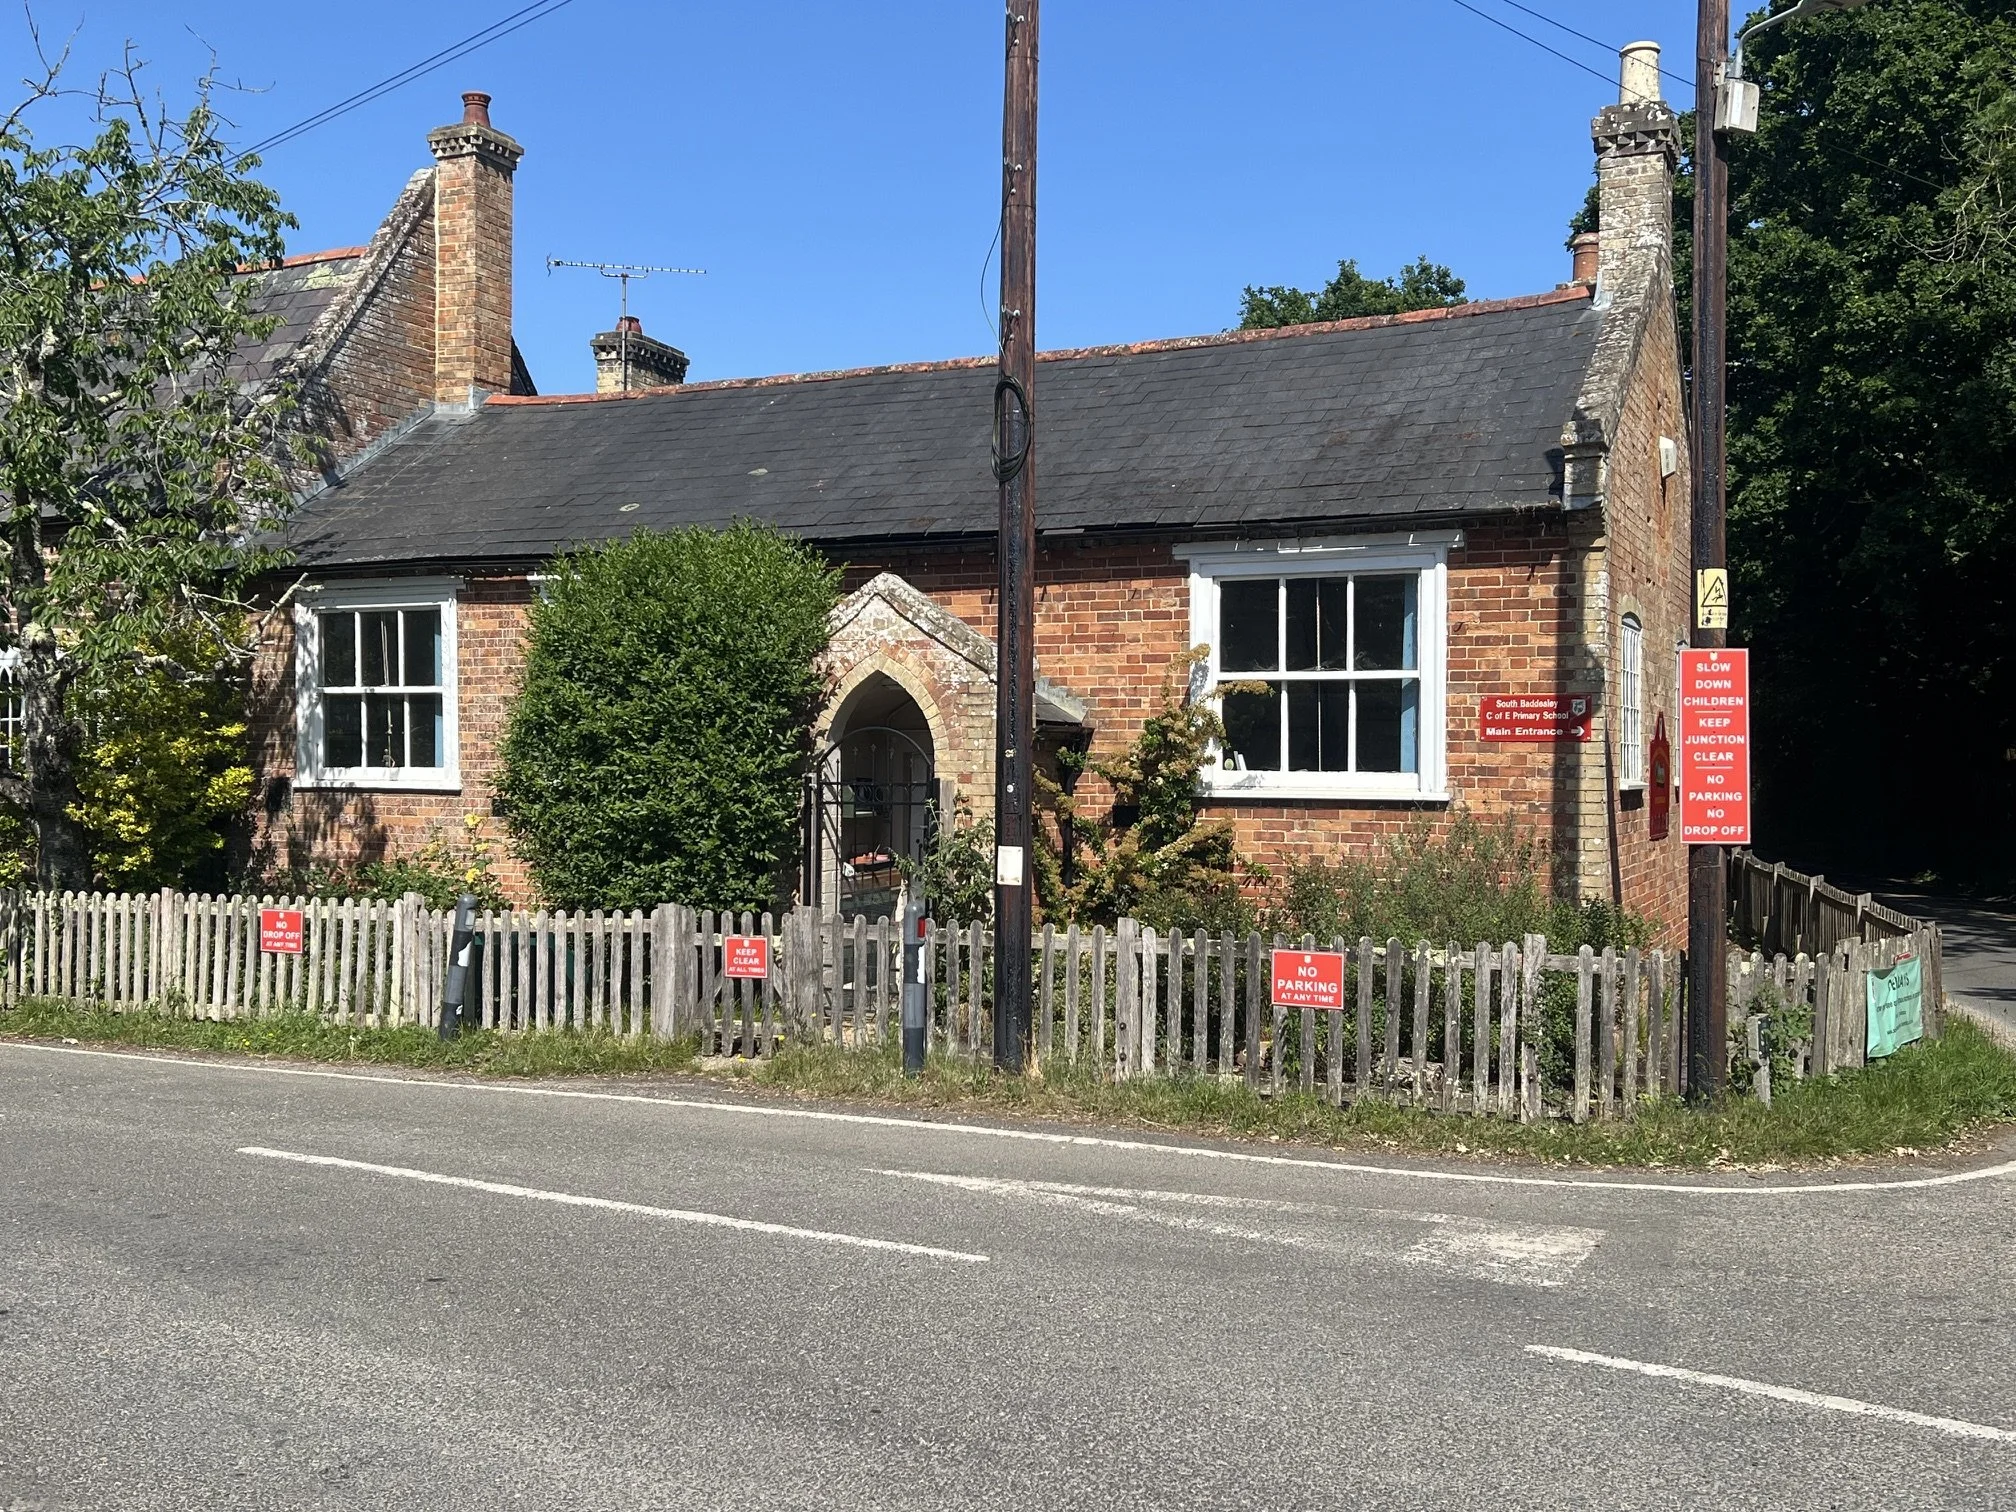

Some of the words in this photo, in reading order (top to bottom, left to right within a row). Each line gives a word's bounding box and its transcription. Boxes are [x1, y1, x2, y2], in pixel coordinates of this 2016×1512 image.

[1696, 662, 1731, 672] SLOW
[1695, 679, 1732, 689] DOWN
[1496, 699, 1518, 708] South
[1520, 699, 1558, 709] Baddesley
[1683, 696, 1744, 706] CHILDREN
[1486, 711, 1493, 720] C
[1494, 711, 1502, 720] of
[1504, 711, 1511, 720] E
[1512, 711, 1541, 721] Primary
[1542, 711, 1569, 720] School
[1699, 718, 1731, 727] KEEP
[1486, 727, 1511, 736] Main
[1515, 727, 1563, 736] Entrance
[1685, 735, 1745, 745] JUNCTION
[1693, 752, 1734, 762] CLEAR
[1706, 774, 1724, 784] NO
[1688, 791, 1742, 801] PARKING
[1706, 809, 1724, 818] NO
[1684, 826, 1718, 835] DROP
[1720, 826, 1745, 835] OFF
[276, 921, 287, 929] NO
[263, 930, 284, 939] DROP
[285, 931, 301, 940] OFF
[735, 948, 757, 956] KEEP
[733, 957, 760, 965] CLEAR
[1297, 966, 1318, 978] NO
[1277, 979, 1338, 994] PARKING
[1281, 992, 1293, 1000] AT
[1293, 993, 1312, 1001] ANY
[1313, 994, 1335, 1003] TIME
